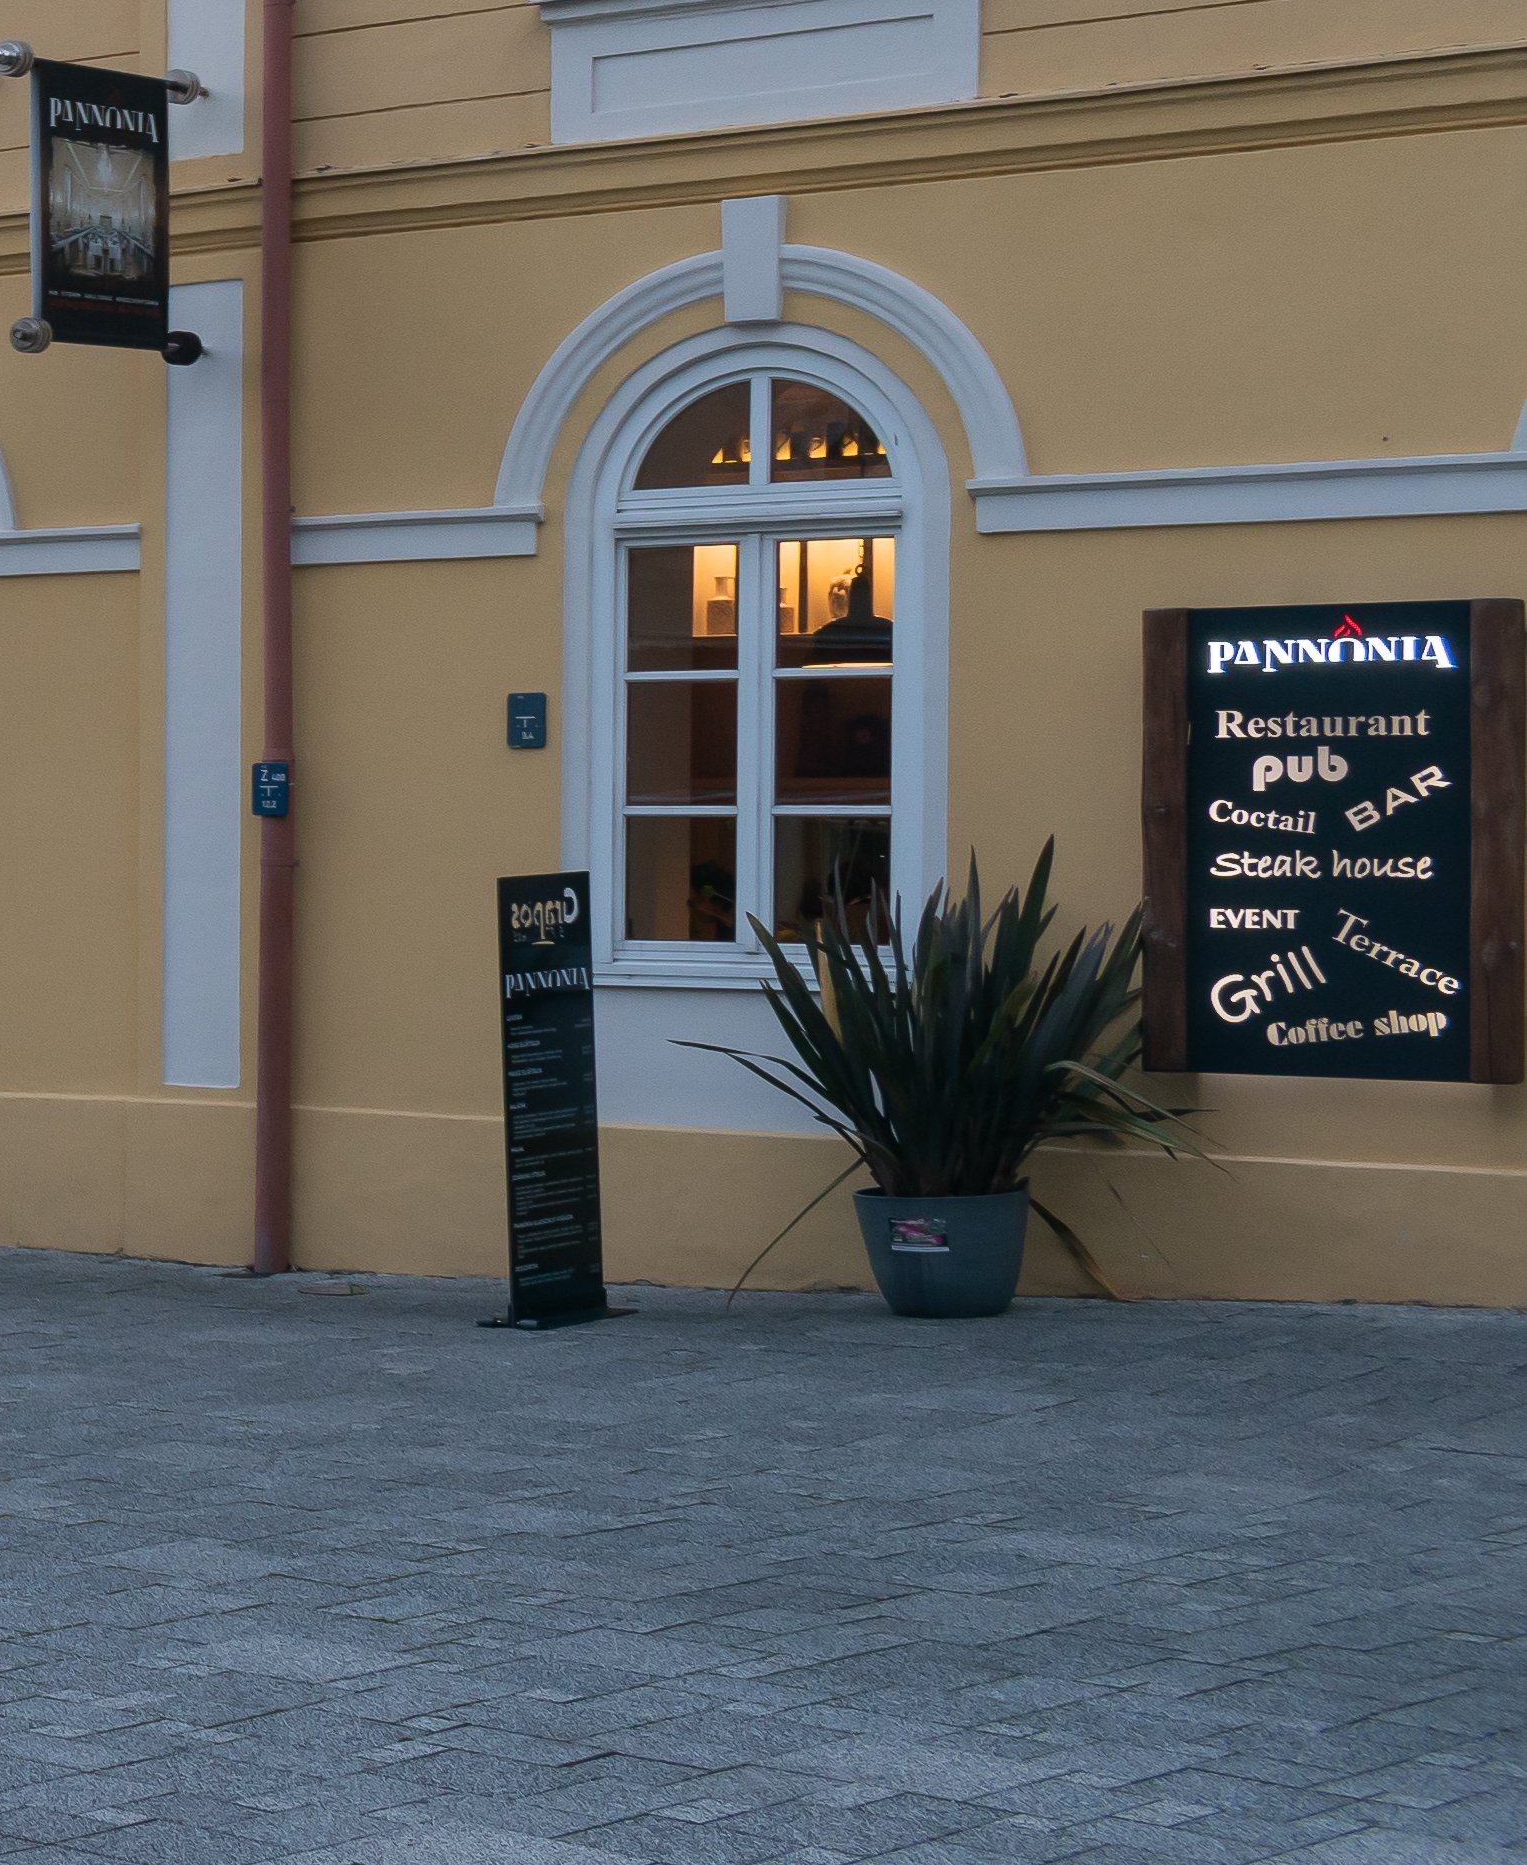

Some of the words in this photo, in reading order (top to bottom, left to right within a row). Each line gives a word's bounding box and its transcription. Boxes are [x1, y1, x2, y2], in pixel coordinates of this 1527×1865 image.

[49, 97, 159, 143] PANNONIA
[1207, 635, 1458, 674] PANNONIA
[1214, 709, 1431, 739] Restaurant
[1253, 746, 1349, 792] pub
[1208, 799, 1317, 835] Coctail
[1344, 765, 1453, 832] BAR
[1209, 850, 1321, 880] Steak
[1332, 849, 1434, 880] house
[1209, 908, 1300, 930] EVENT
[1331, 908, 1461, 996] Terrace
[504, 967, 591, 998] PANNONIA
[1210, 946, 1327, 1024] Grill
[1266, 1018, 1364, 1047] Coffee
[1373, 1009, 1448, 1040] shop
